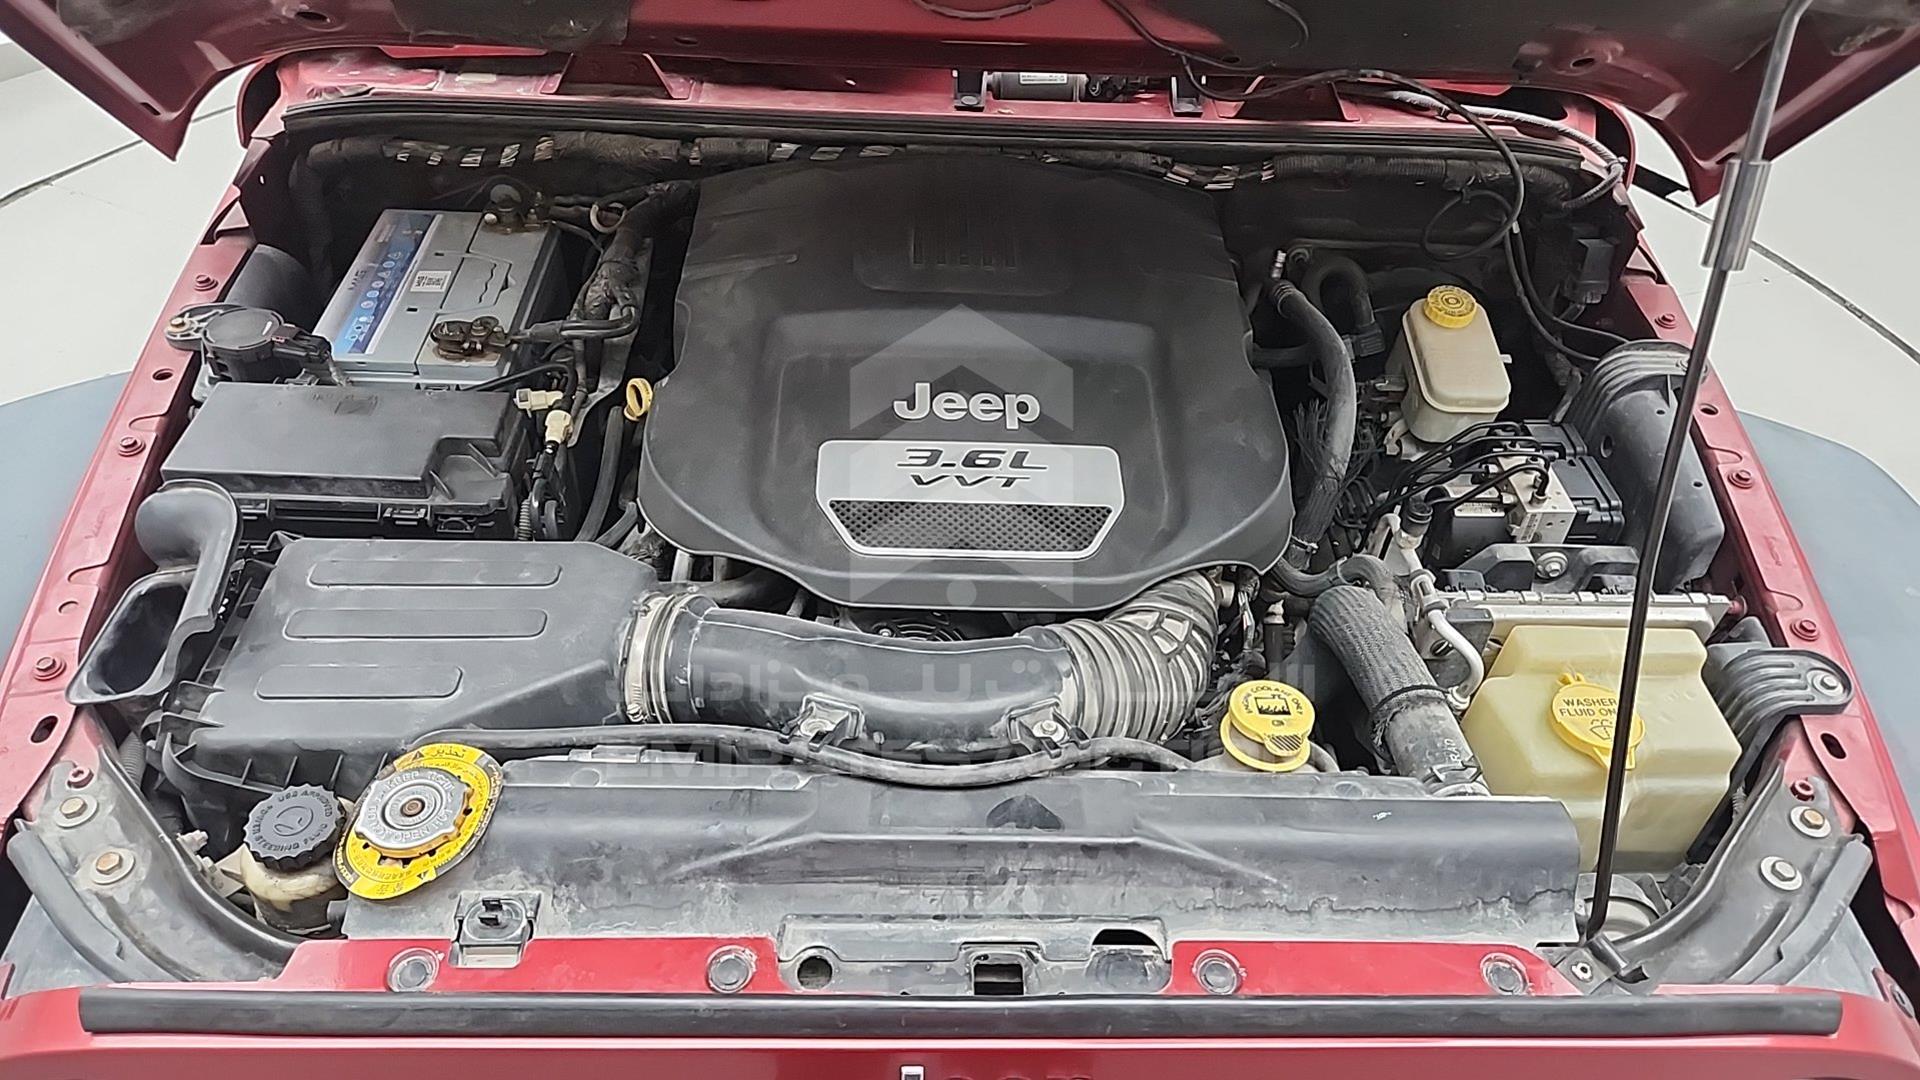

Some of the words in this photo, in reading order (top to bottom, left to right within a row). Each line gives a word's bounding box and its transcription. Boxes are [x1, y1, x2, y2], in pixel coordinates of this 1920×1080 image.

[893, 382, 1041, 430] Jeep
[897, 448, 1049, 470] 3.6L
[909, 474, 1031, 488] VVT
[1563, 697, 1618, 707] WASHER
[1559, 708, 1596, 717] FLUID
[1598, 708, 1618, 717] ON
[394, 826, 431, 842] OPEN
